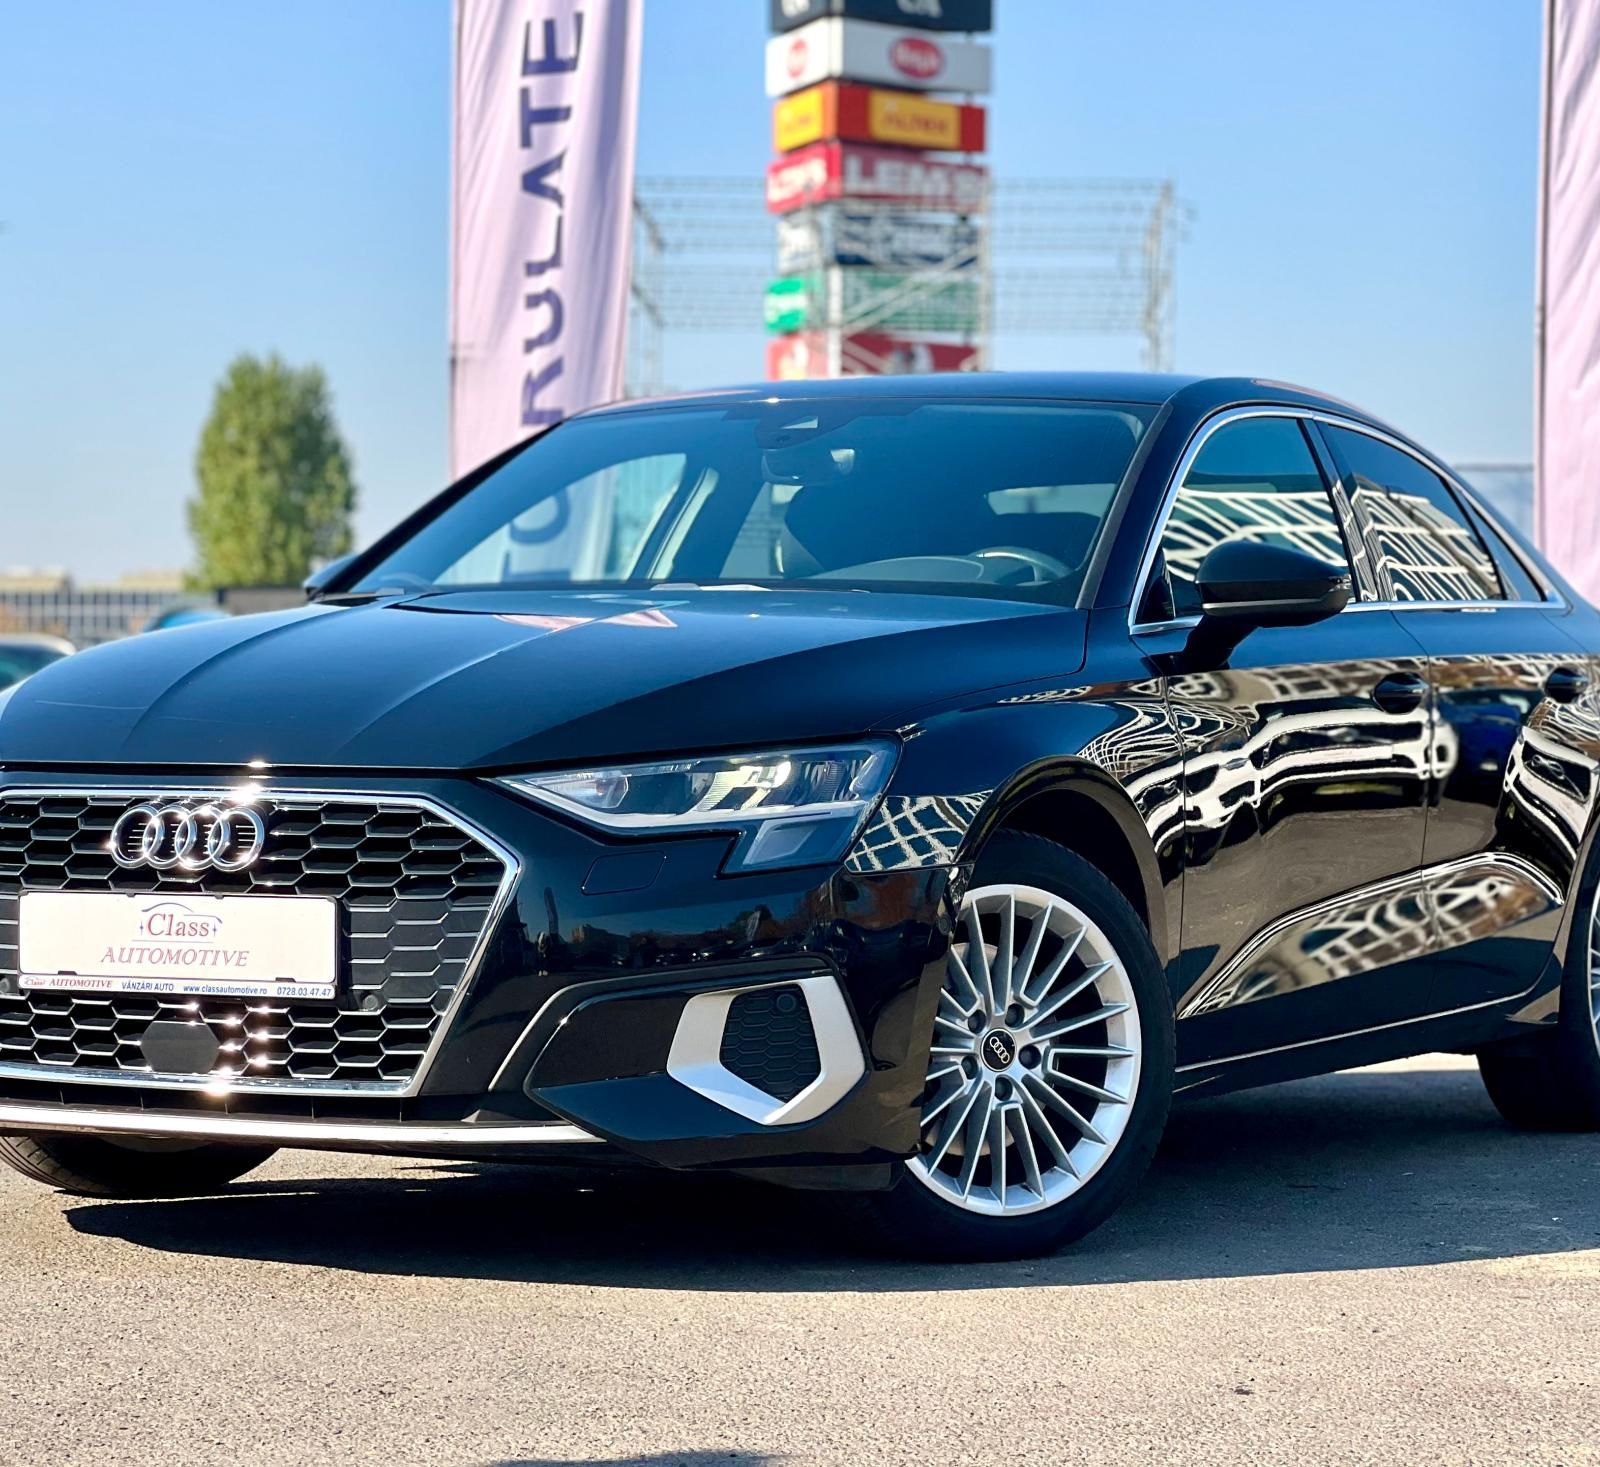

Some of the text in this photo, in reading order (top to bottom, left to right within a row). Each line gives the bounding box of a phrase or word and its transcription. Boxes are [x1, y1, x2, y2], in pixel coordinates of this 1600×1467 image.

[520, 11, 584, 426] RULATE
[147, 913, 210, 936] Class
[100, 946, 250, 967] AUTOMOTIVE
[49, 977, 113, 988] AUTOMOTIVE
[154, 982, 175, 992] AUTO
[183, 984, 267, 995] www.classautomotive.ro
[277, 986, 332, 997] 0728.03.47.47
